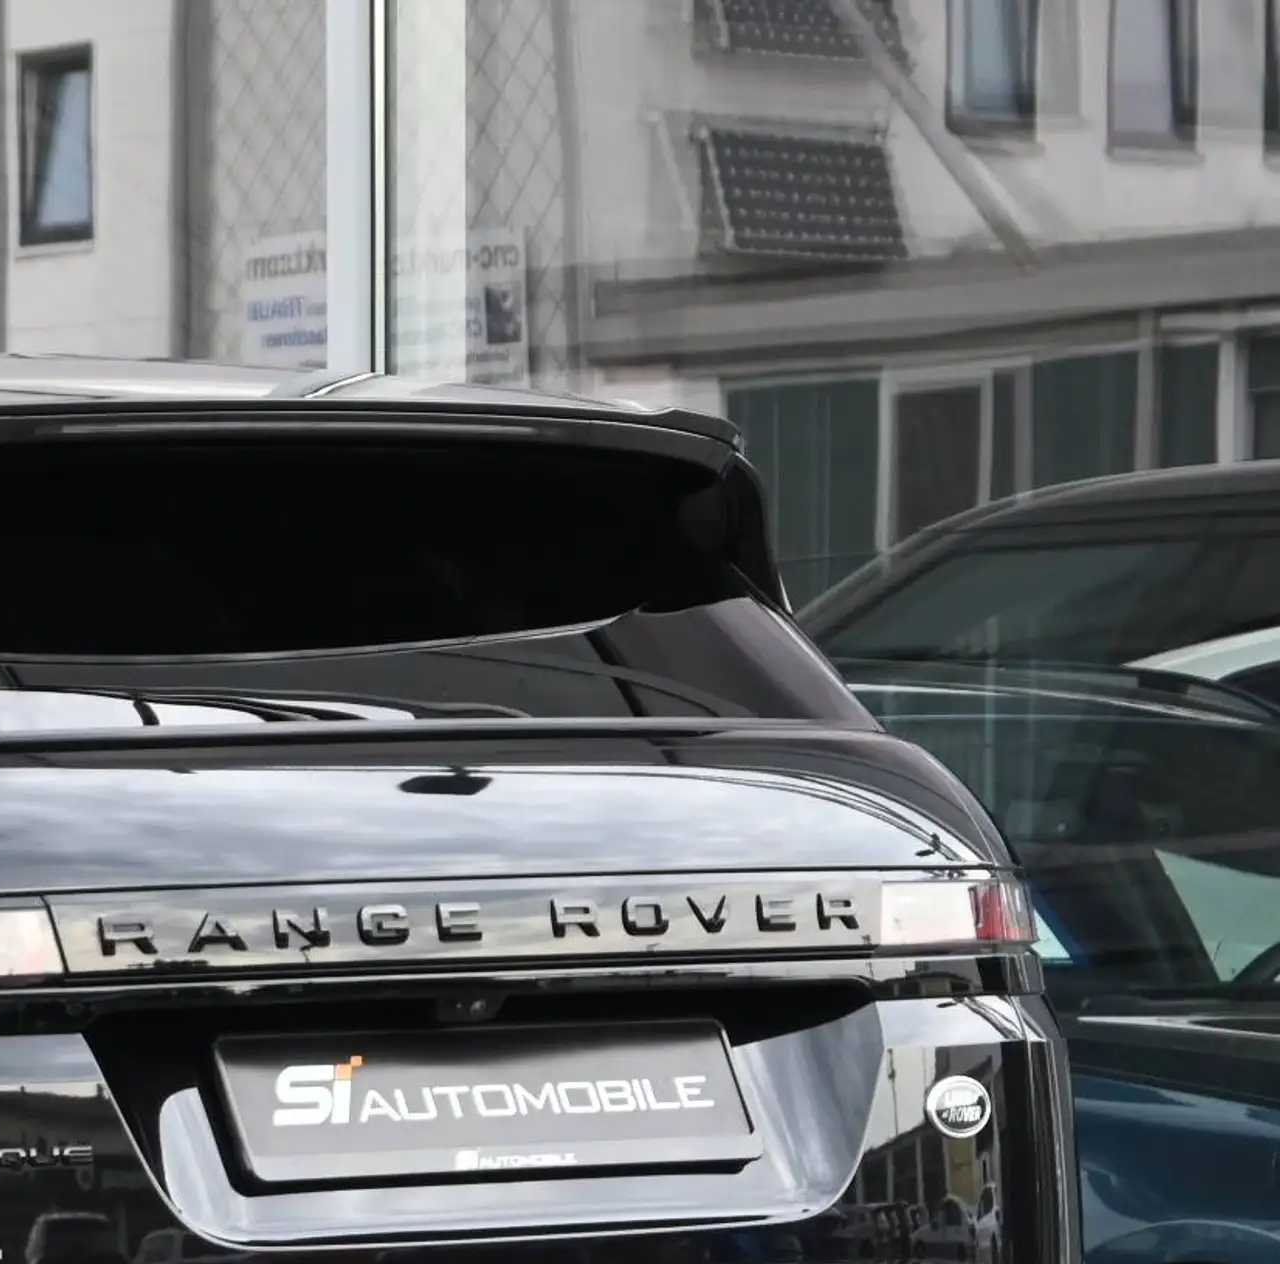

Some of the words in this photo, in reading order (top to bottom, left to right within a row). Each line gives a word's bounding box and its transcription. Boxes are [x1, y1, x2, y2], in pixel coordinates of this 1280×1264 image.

[97, 902, 483, 956] RANGE
[550, 893, 860, 939] ROVER
[359, 1075, 715, 1124] AUTOMOBILE
